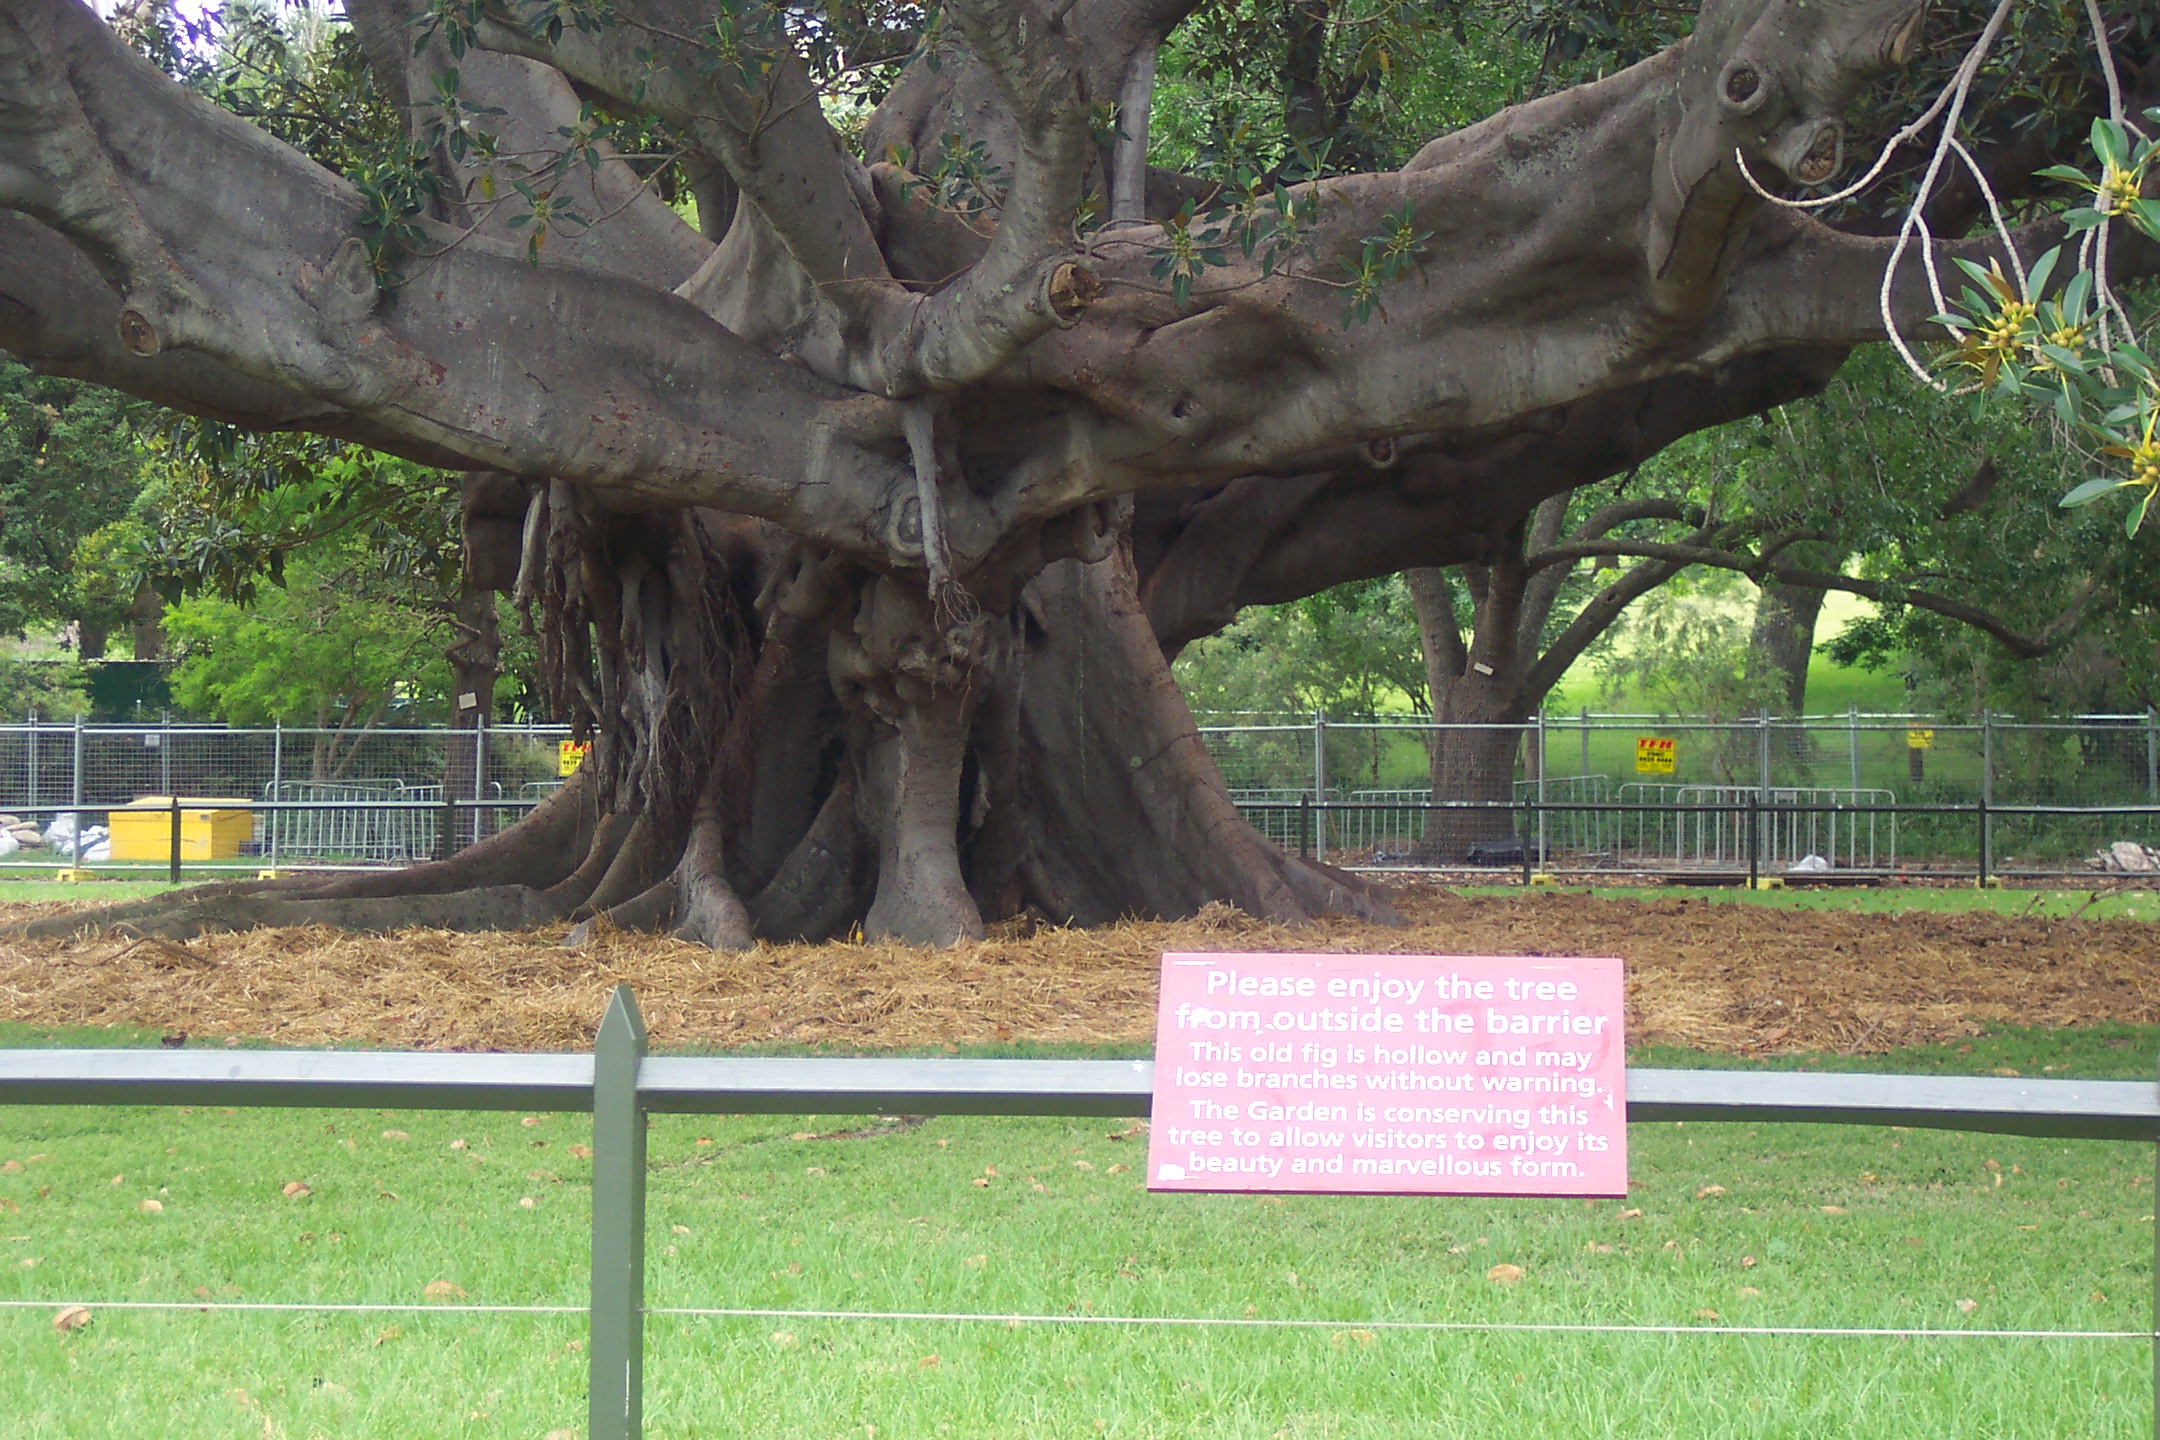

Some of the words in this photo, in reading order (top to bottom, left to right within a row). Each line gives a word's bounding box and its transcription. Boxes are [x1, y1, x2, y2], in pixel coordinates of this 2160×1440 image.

[1207, 970, 1316, 997] Please
[1327, 972, 1424, 1004] enjoy
[1435, 974, 1494, 1000] the
[1504, 976, 1578, 1000] tree
[1272, 1005, 1403, 1032] outside
[1414, 1008, 1474, 1034] the
[1487, 1010, 1608, 1036] barrier
[1189, 1041, 1242, 1062] This
[1249, 1043, 1292, 1064] old
[1301, 1043, 1337, 1068] fig
[1347, 1045, 1365, 1065] is
[1374, 1045, 1467, 1066] hollow
[1475, 1046, 1526, 1067] and
[1535, 1051, 1592, 1072] may
[1176, 1068, 1228, 1088] lose
[1236, 1069, 1357, 1090] branches
[1365, 1071, 1474, 1092] without
[1482, 1074, 1604, 1097] warning.
[1189, 1100, 1239, 1120] The
[1248, 1100, 1347, 1122] Garden
[1357, 1102, 1376, 1122] is
[1384, 1103, 1530, 1129] conserving
[1538, 1105, 1588, 1125] this
[1168, 1127, 1223, 1147] tree
[1231, 1129, 1260, 1147] to
[1269, 1129, 1344, 1149] allow
[1352, 1129, 1446, 1150] visitors
[1454, 1132, 1485, 1151] to
[1493, 1132, 1569, 1157] enjoy
[1577, 1132, 1608, 1152] its
[1188, 1153, 1283, 1178] beauty
[1291, 1154, 1343, 1175] and
[1352, 1154, 1502, 1176] marvellous
[1510, 1155, 1586, 1178] form.
